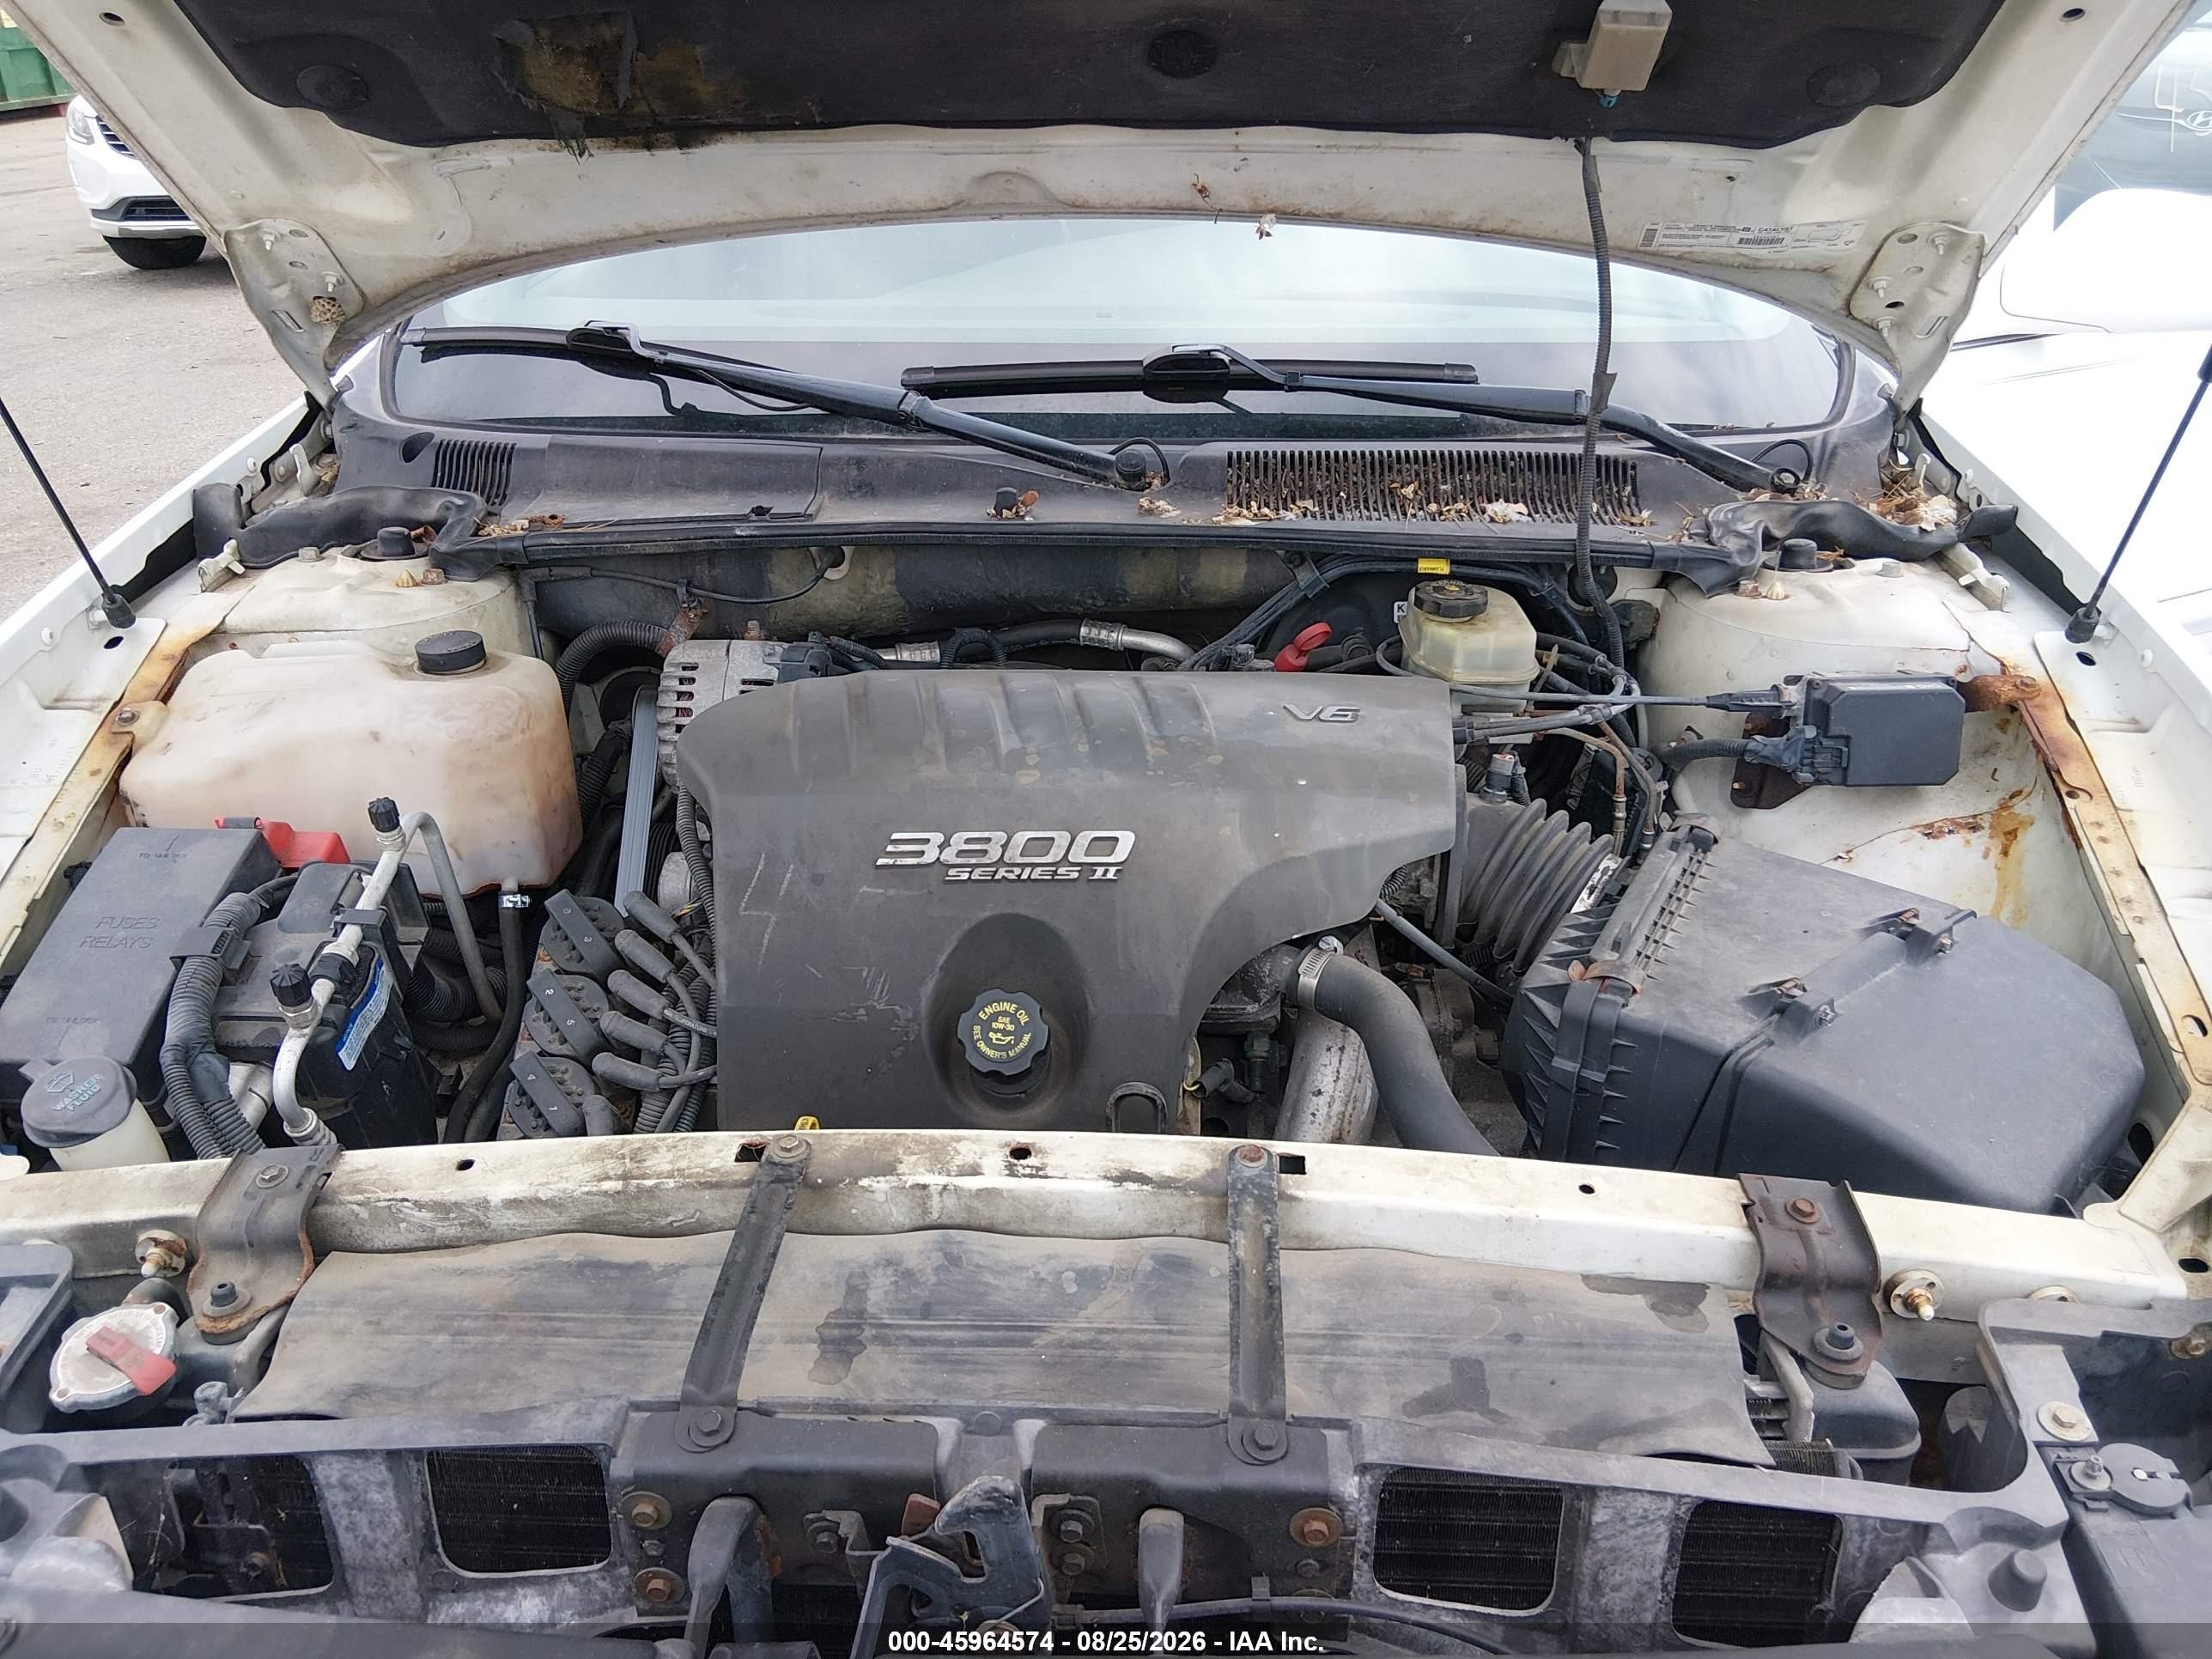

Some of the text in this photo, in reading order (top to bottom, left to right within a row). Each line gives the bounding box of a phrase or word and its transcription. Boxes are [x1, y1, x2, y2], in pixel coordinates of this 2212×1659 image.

[1283, 704, 1360, 722] V6
[875, 830, 1136, 867] 3800
[945, 866, 1123, 882] SERIES II
[95, 915, 160, 928] FUSES
[79, 935, 154, 949] RELAYS
[979, 1001, 1030, 1026] ENGINE OIL
[991, 1022, 1015, 1031] 10W-30
[973, 1024, 1031, 1059] SEE OWNER'S MANUAL
[527, 1073, 537, 1082] 4
[52, 1073, 104, 1111] WASHER
[66, 1084, 101, 1111] FLUID
